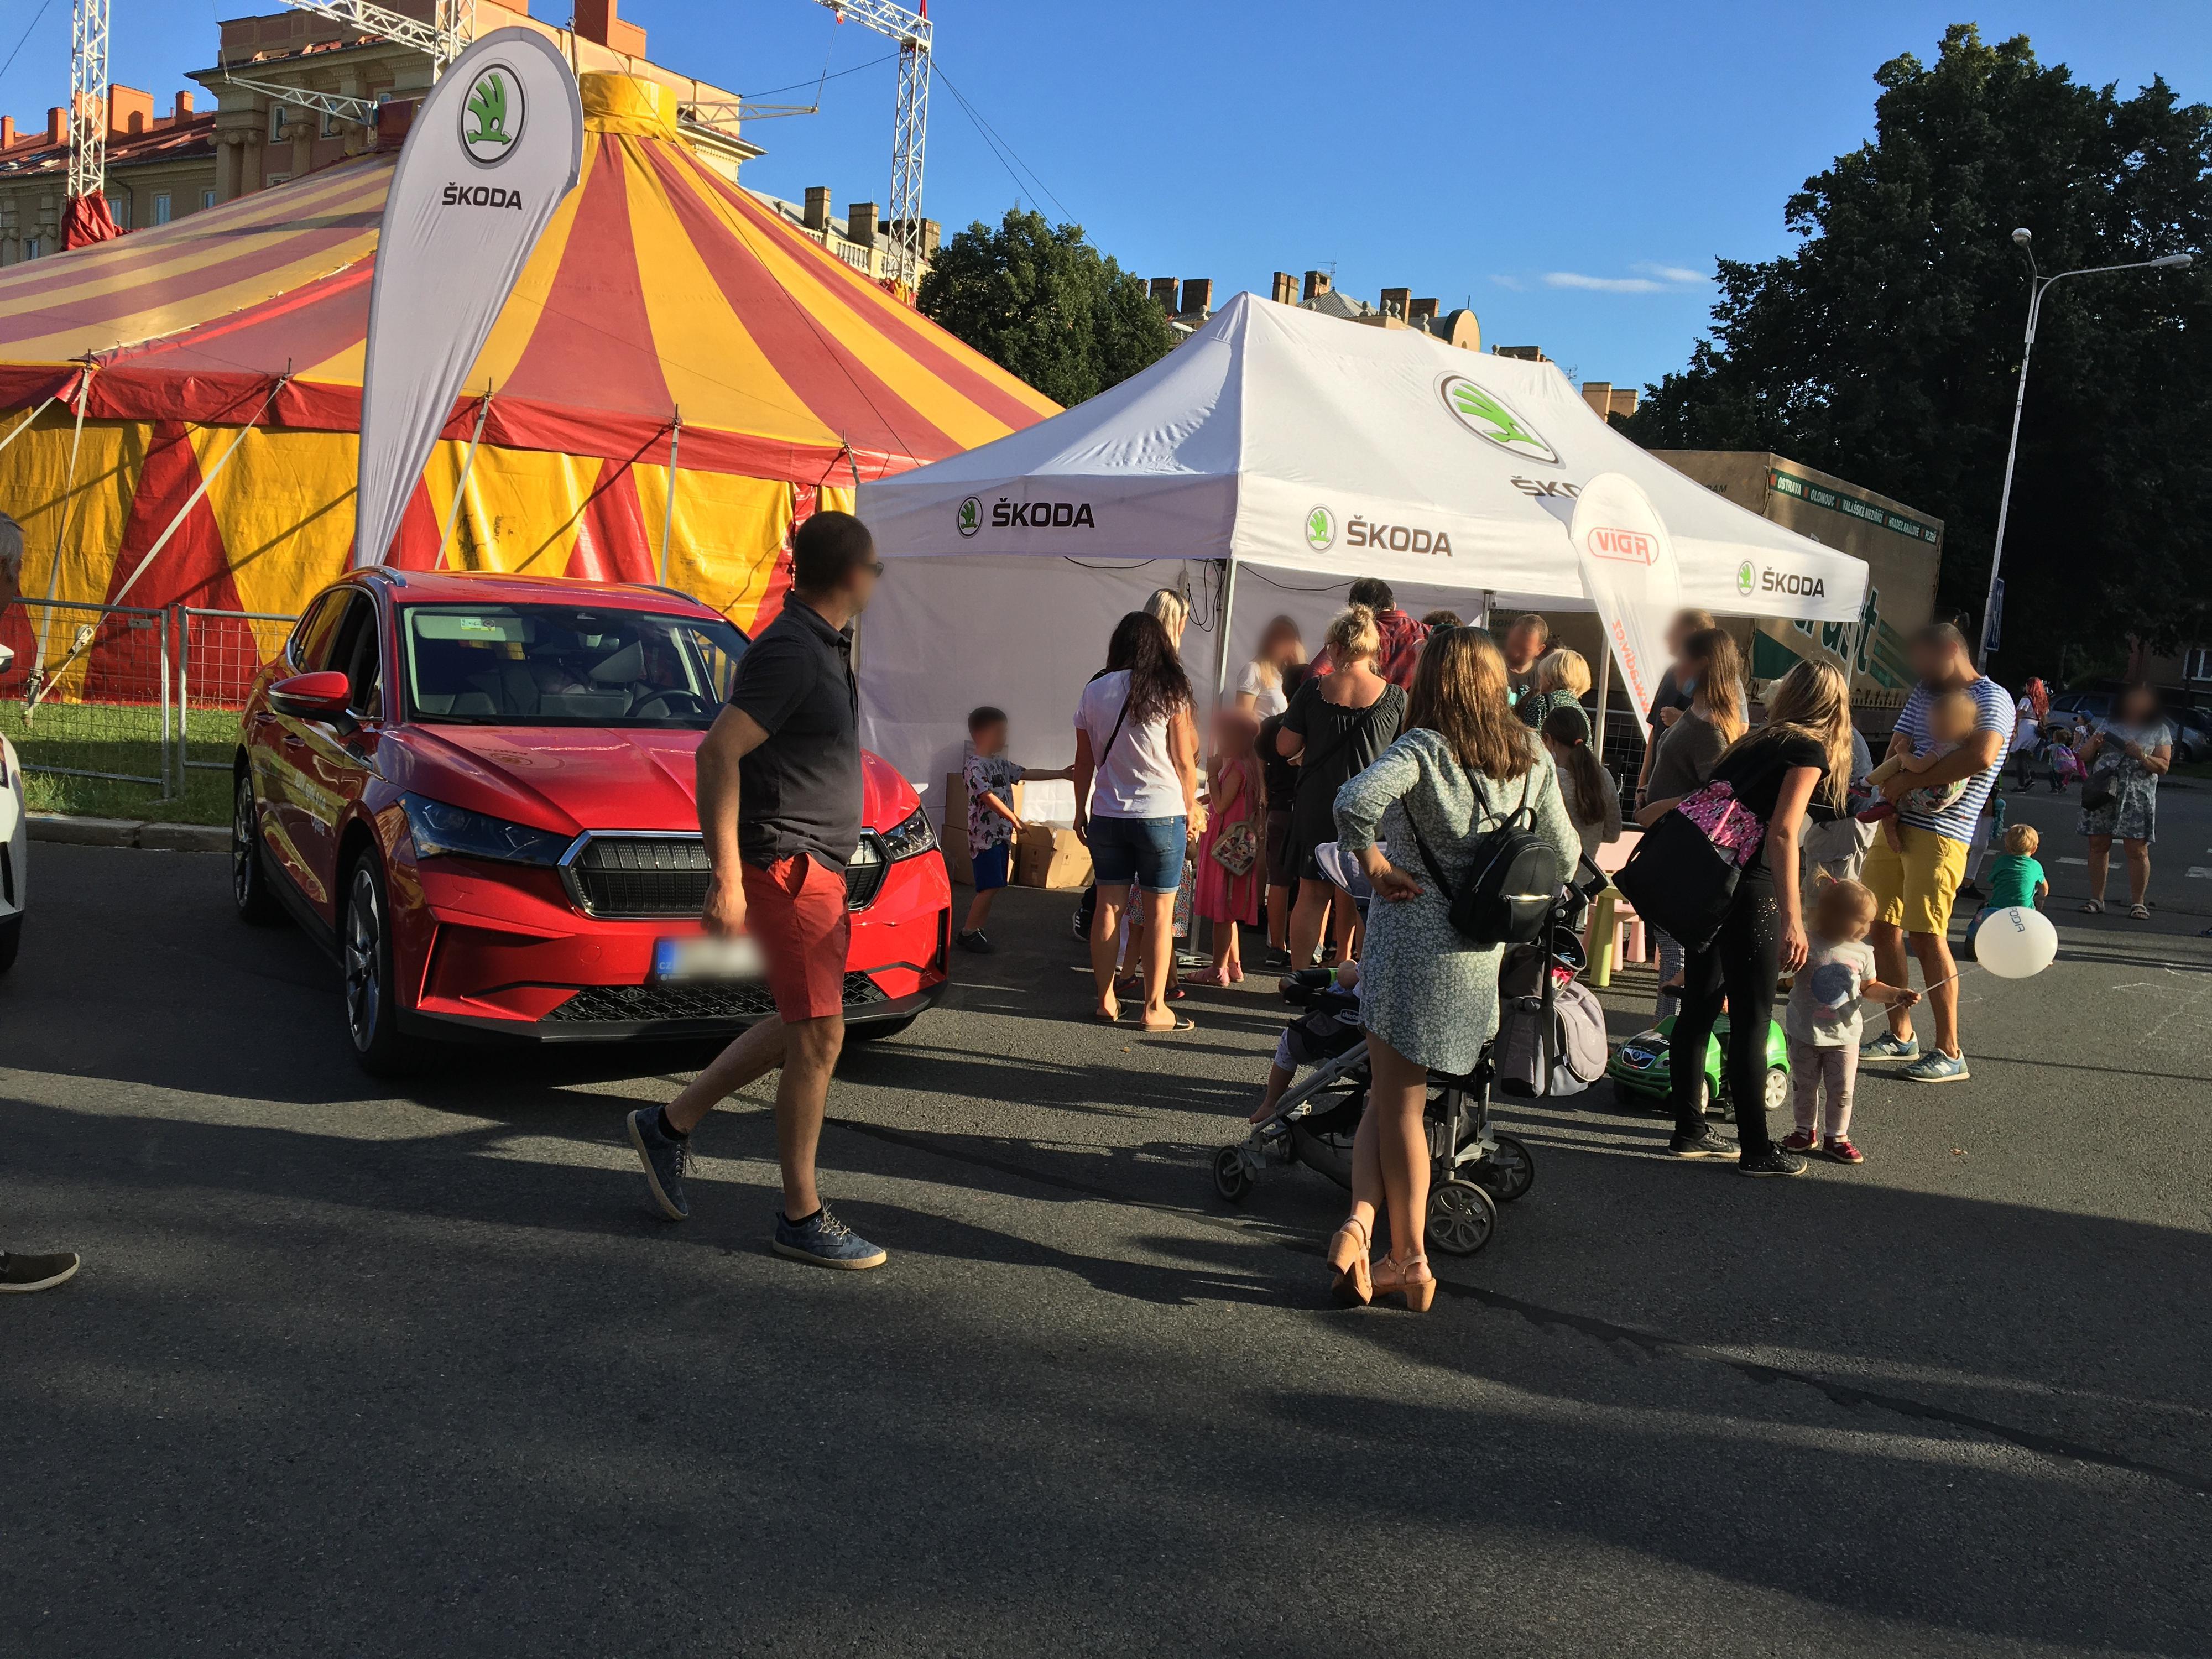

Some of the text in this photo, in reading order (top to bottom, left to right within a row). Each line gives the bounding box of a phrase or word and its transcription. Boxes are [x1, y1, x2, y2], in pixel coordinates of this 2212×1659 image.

[442, 182, 523, 210] ŠKODA
[1777, 476, 1801, 496] OSTRAVA
[1811, 489, 1835, 507] OLOMOUC
[992, 498, 1095, 528] ŠKODA
[1347, 514, 1453, 557] ŠKODA
[1761, 566, 1825, 598] ŠKODA
[659, 962, 672, 970] CZ
